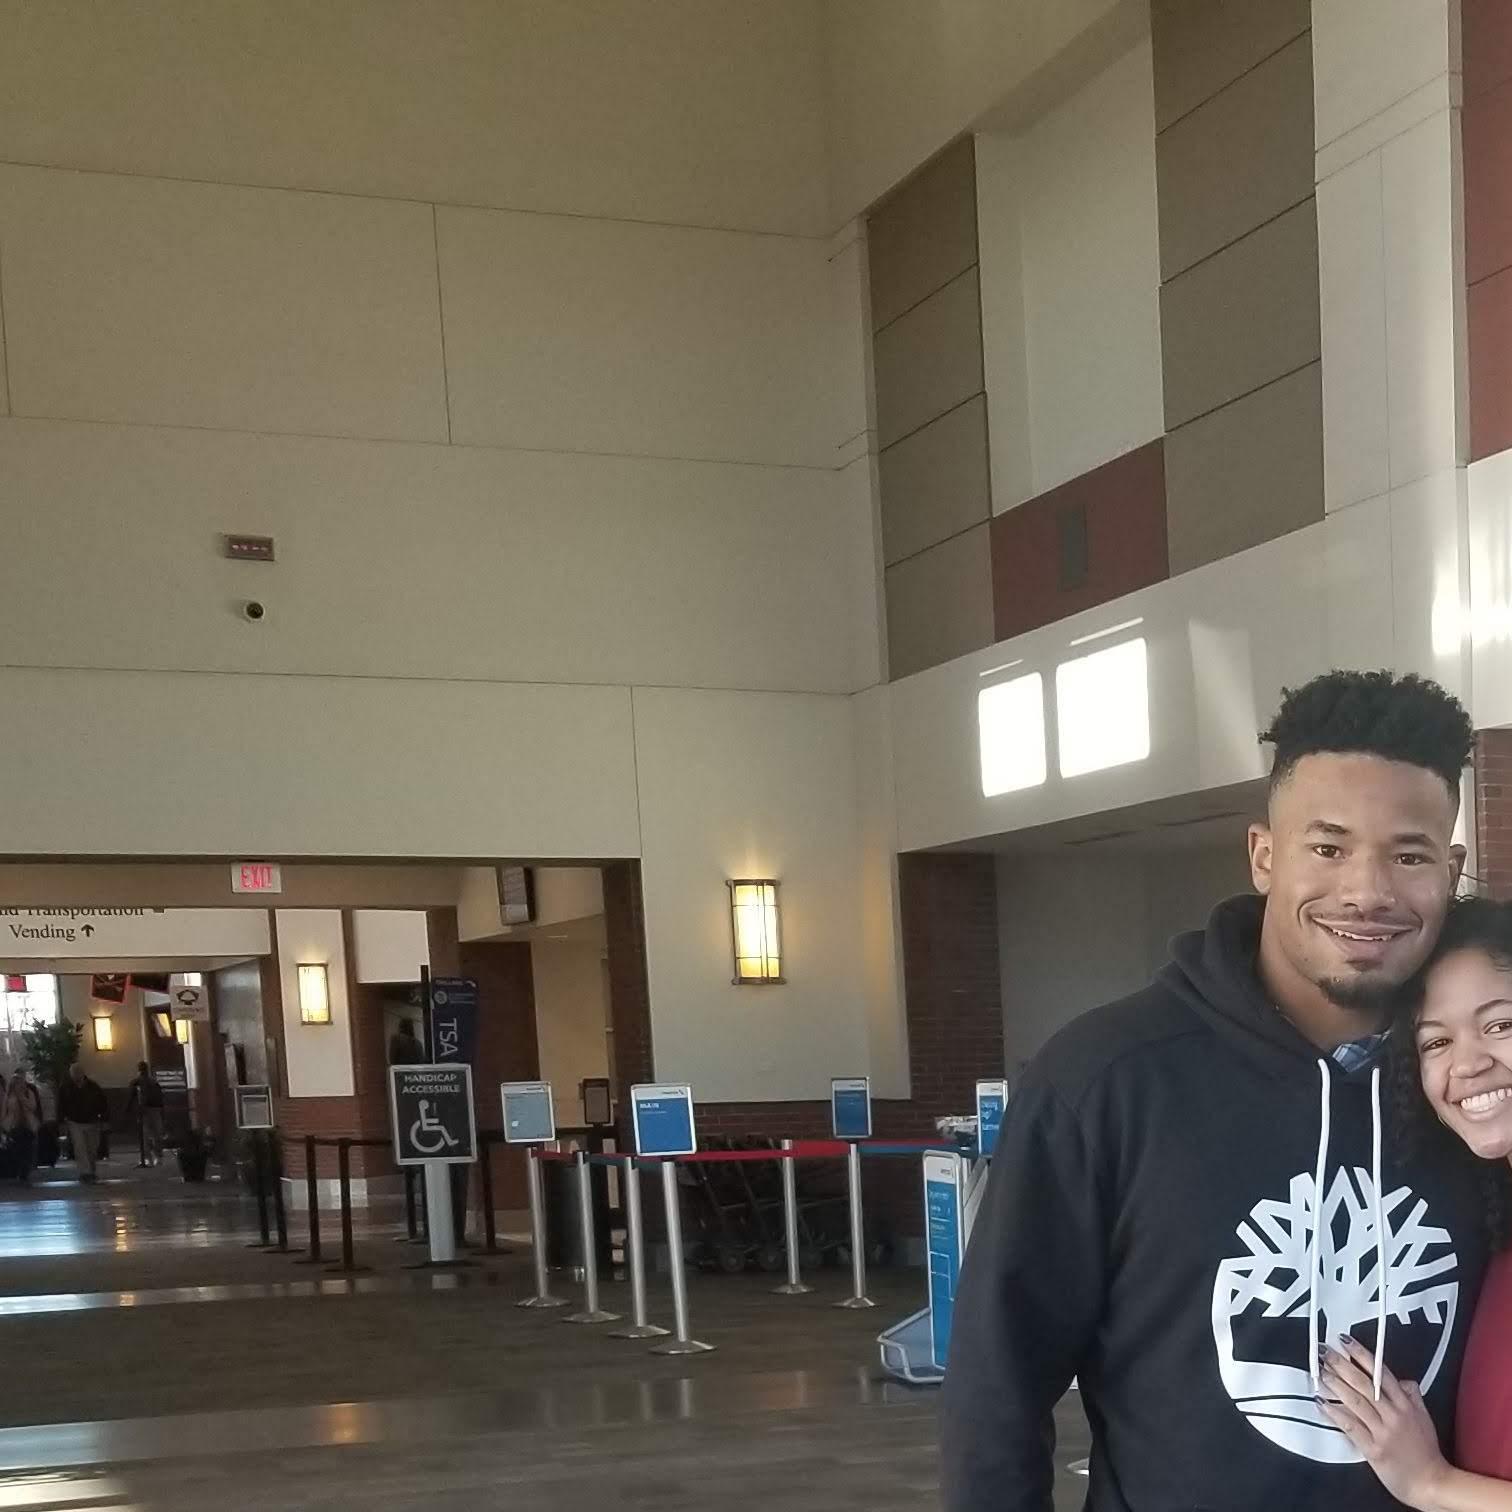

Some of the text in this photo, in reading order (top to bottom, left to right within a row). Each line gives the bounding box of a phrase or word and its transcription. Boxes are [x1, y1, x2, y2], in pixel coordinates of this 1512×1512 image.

[240, 862, 273, 888] EXIT
[8, 923, 76, 942] Vending
[439, 1017, 458, 1057] TSA
[404, 1073, 457, 1082] HANDICAP
[402, 1084, 460, 1094] ACCESSIBLE
